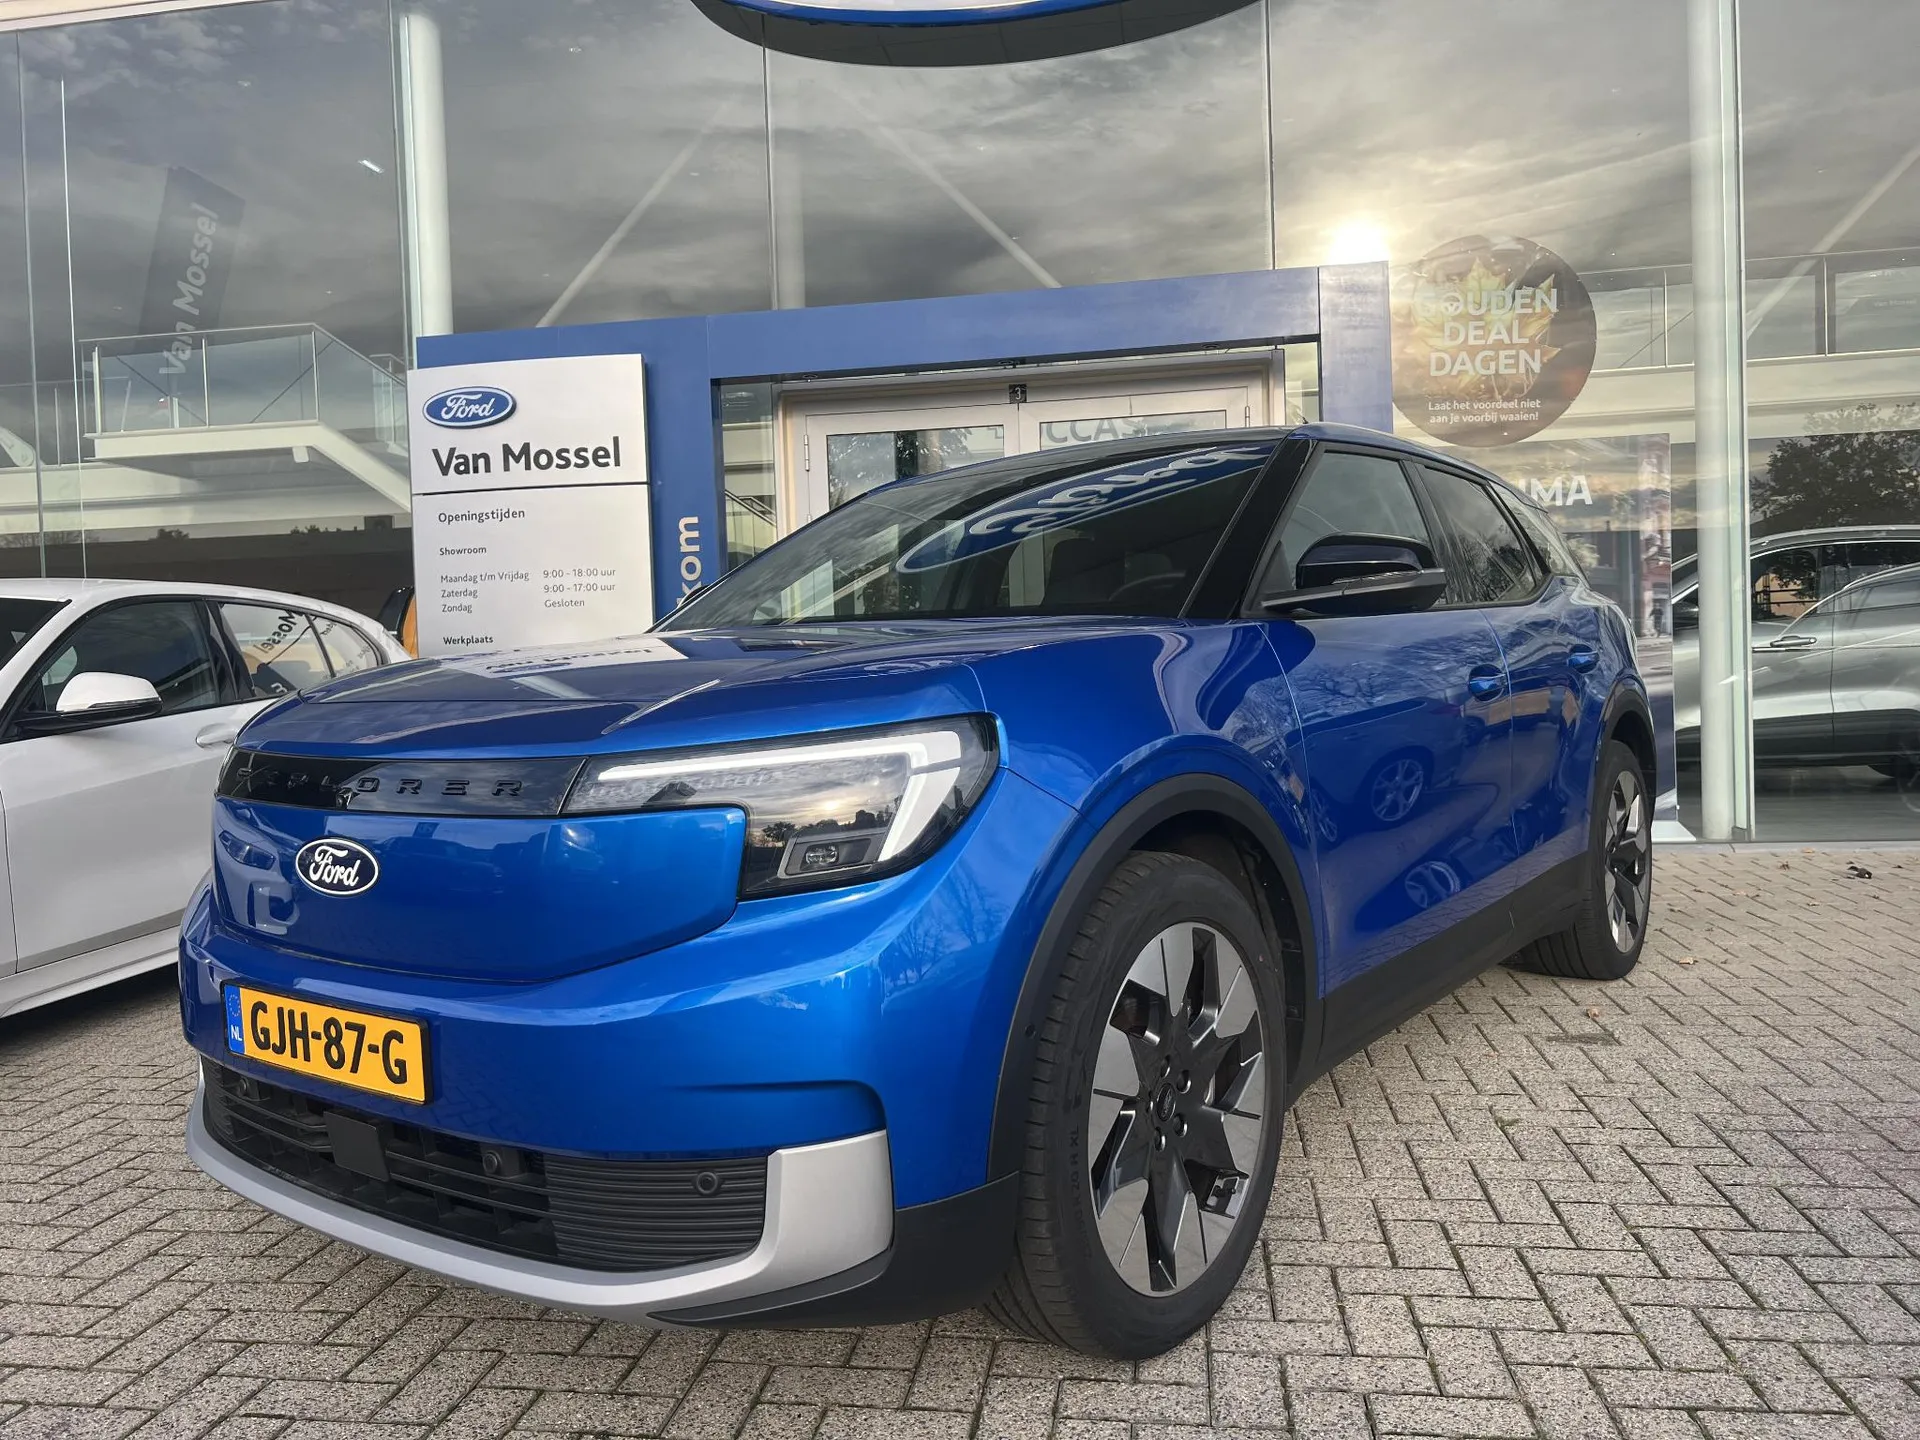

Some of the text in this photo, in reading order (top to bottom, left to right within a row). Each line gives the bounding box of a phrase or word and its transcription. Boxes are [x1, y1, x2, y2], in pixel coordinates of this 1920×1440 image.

[159, 202, 219, 374] Van Mossel
[1412, 288, 1559, 317] GOUDEN
[1443, 320, 1529, 346] DEAL
[1429, 349, 1542, 377] DAGEN
[1015, 387, 1022, 400] 3
[440, 393, 496, 420] Ford
[1428, 399, 1541, 411] Laat het voordeel niet
[1430, 412, 1539, 424] aan je voorbij waaien!
[432, 436, 621, 477] Van Mossel
[438, 508, 525, 525] Openingstijden
[439, 546, 487, 556] Showroom
[440, 573, 478, 584] Maandag
[480, 572, 496, 582] t/m
[498, 571, 530, 582] Vrijdag
[543, 569, 564, 579] 9:00
[572, 568, 598, 578] 18:00
[600, 569, 616, 577] uur
[441, 588, 478, 599] Zaterdag
[543, 584, 565, 593] 9:00
[573, 582, 598, 592] 17:00
[600, 583, 616, 592] uur
[441, 598, 585, 613] Zondag Gesloten
[443, 635, 494, 647] Werkplaats
[309, 845, 361, 887] Ford
[230, 1025, 243, 1042] NL
[250, 1001, 407, 1085] GJH-87-G
